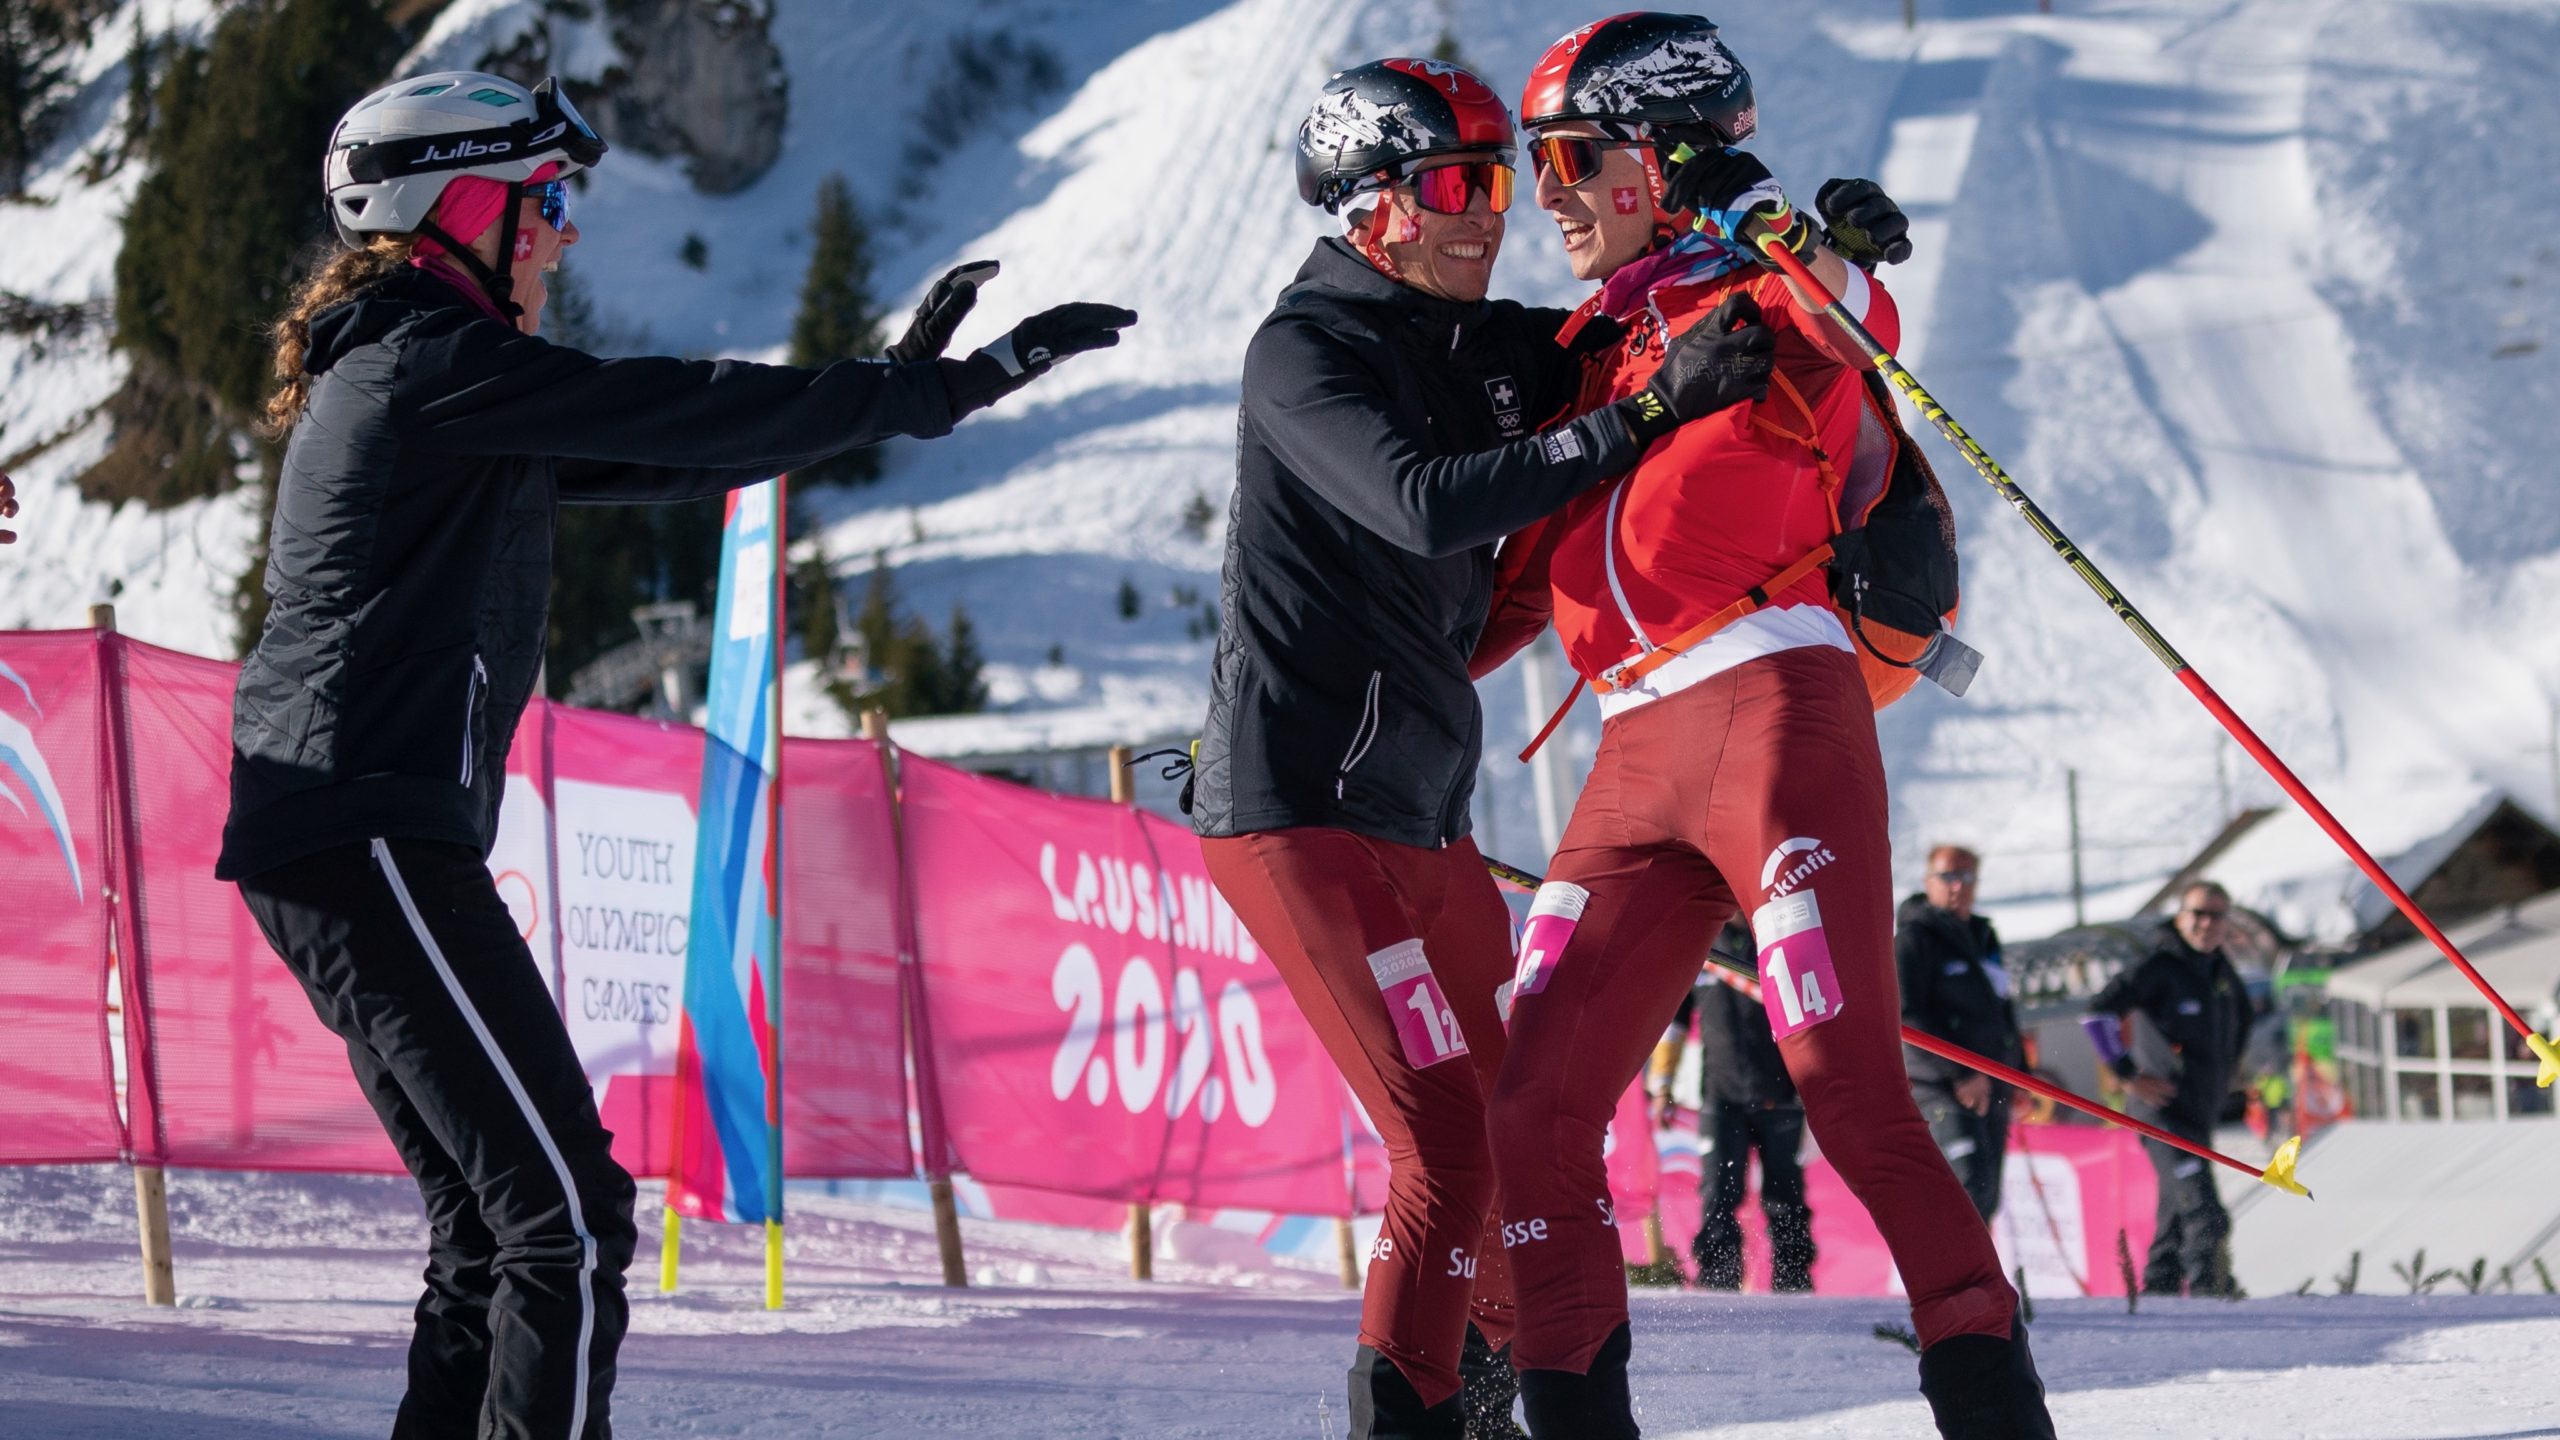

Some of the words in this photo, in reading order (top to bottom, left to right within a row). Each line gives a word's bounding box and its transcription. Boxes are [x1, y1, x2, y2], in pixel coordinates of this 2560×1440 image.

[1722, 74, 1741, 98] CAMP
[410, 140, 511, 165] Julbo
[1299, 140, 1315, 159] CAMP
[1873, 353, 1945, 421] LEKI
[577, 832, 674, 885] YOUTH
[568, 906, 688, 957] OLYMPIC
[583, 978, 670, 1025] GAMES
[1766, 946, 1828, 1028] 14
[1406, 982, 1466, 1057] 12
